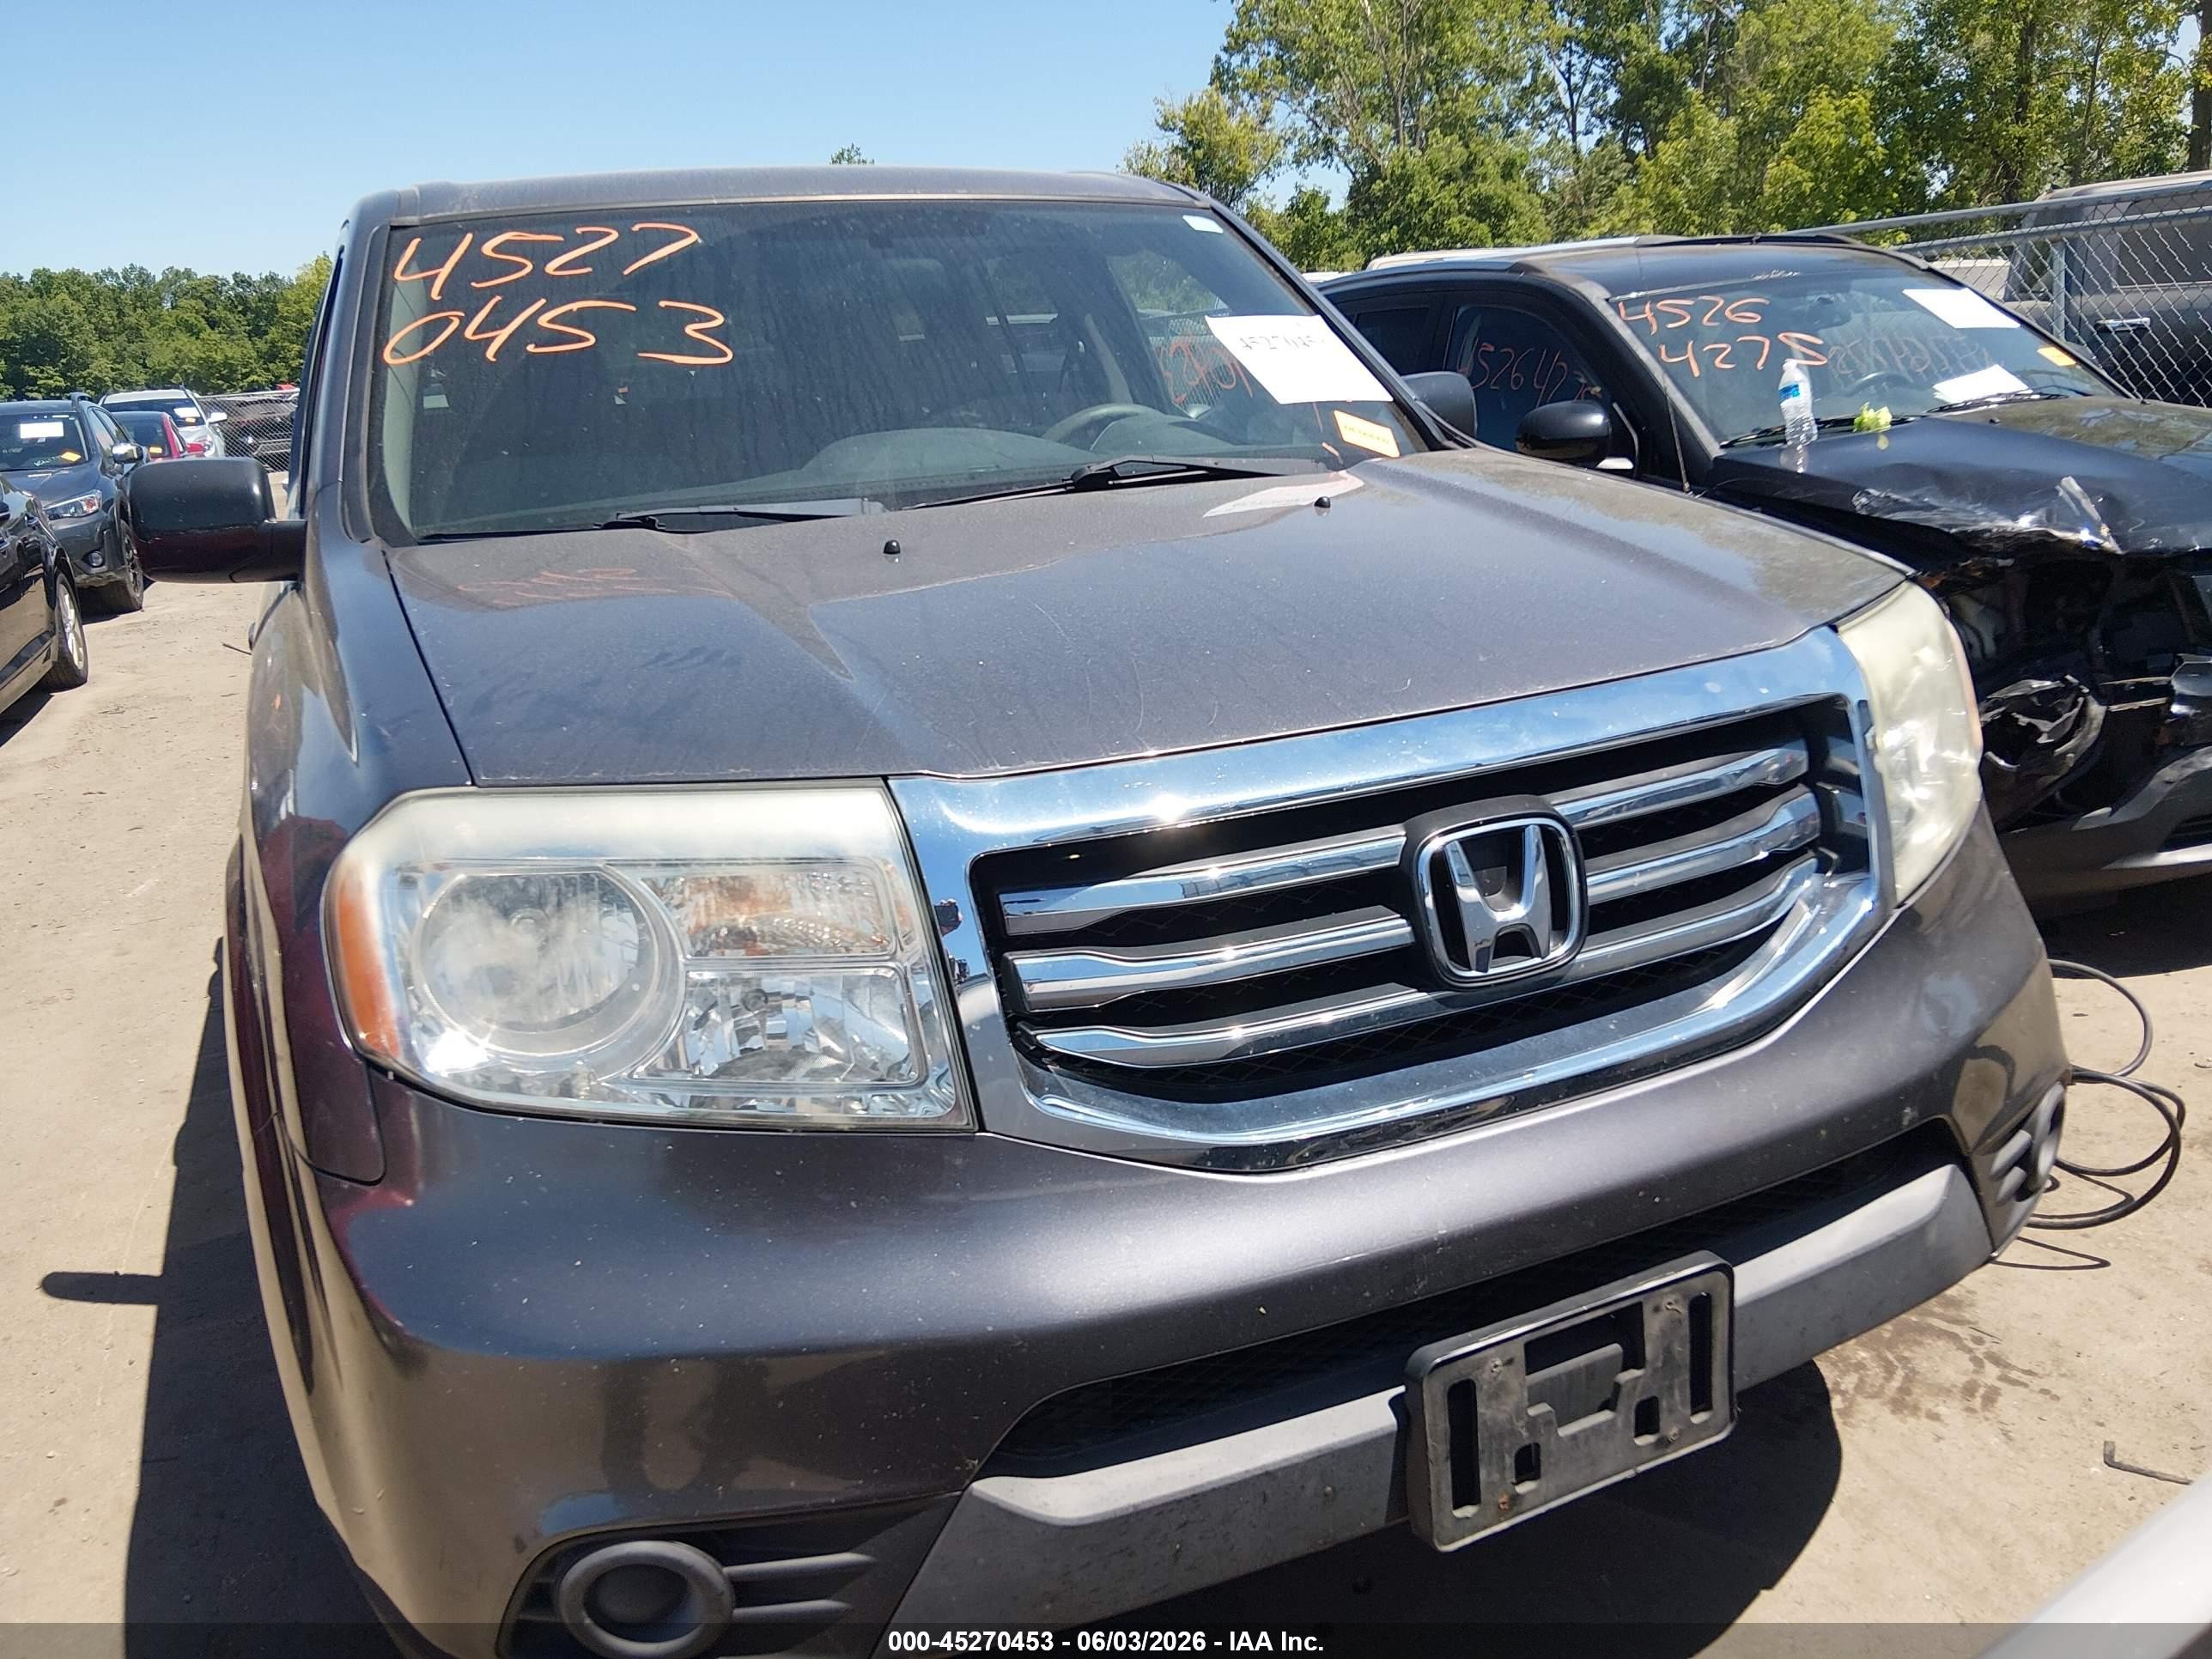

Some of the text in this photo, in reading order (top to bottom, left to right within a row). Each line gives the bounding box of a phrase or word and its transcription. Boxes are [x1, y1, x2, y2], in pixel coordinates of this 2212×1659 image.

[392, 222, 702, 302] 4527
[381, 295, 735, 367] 0453
[1618, 295, 1771, 337] 4526
[1657, 331, 1829, 379] 4275
